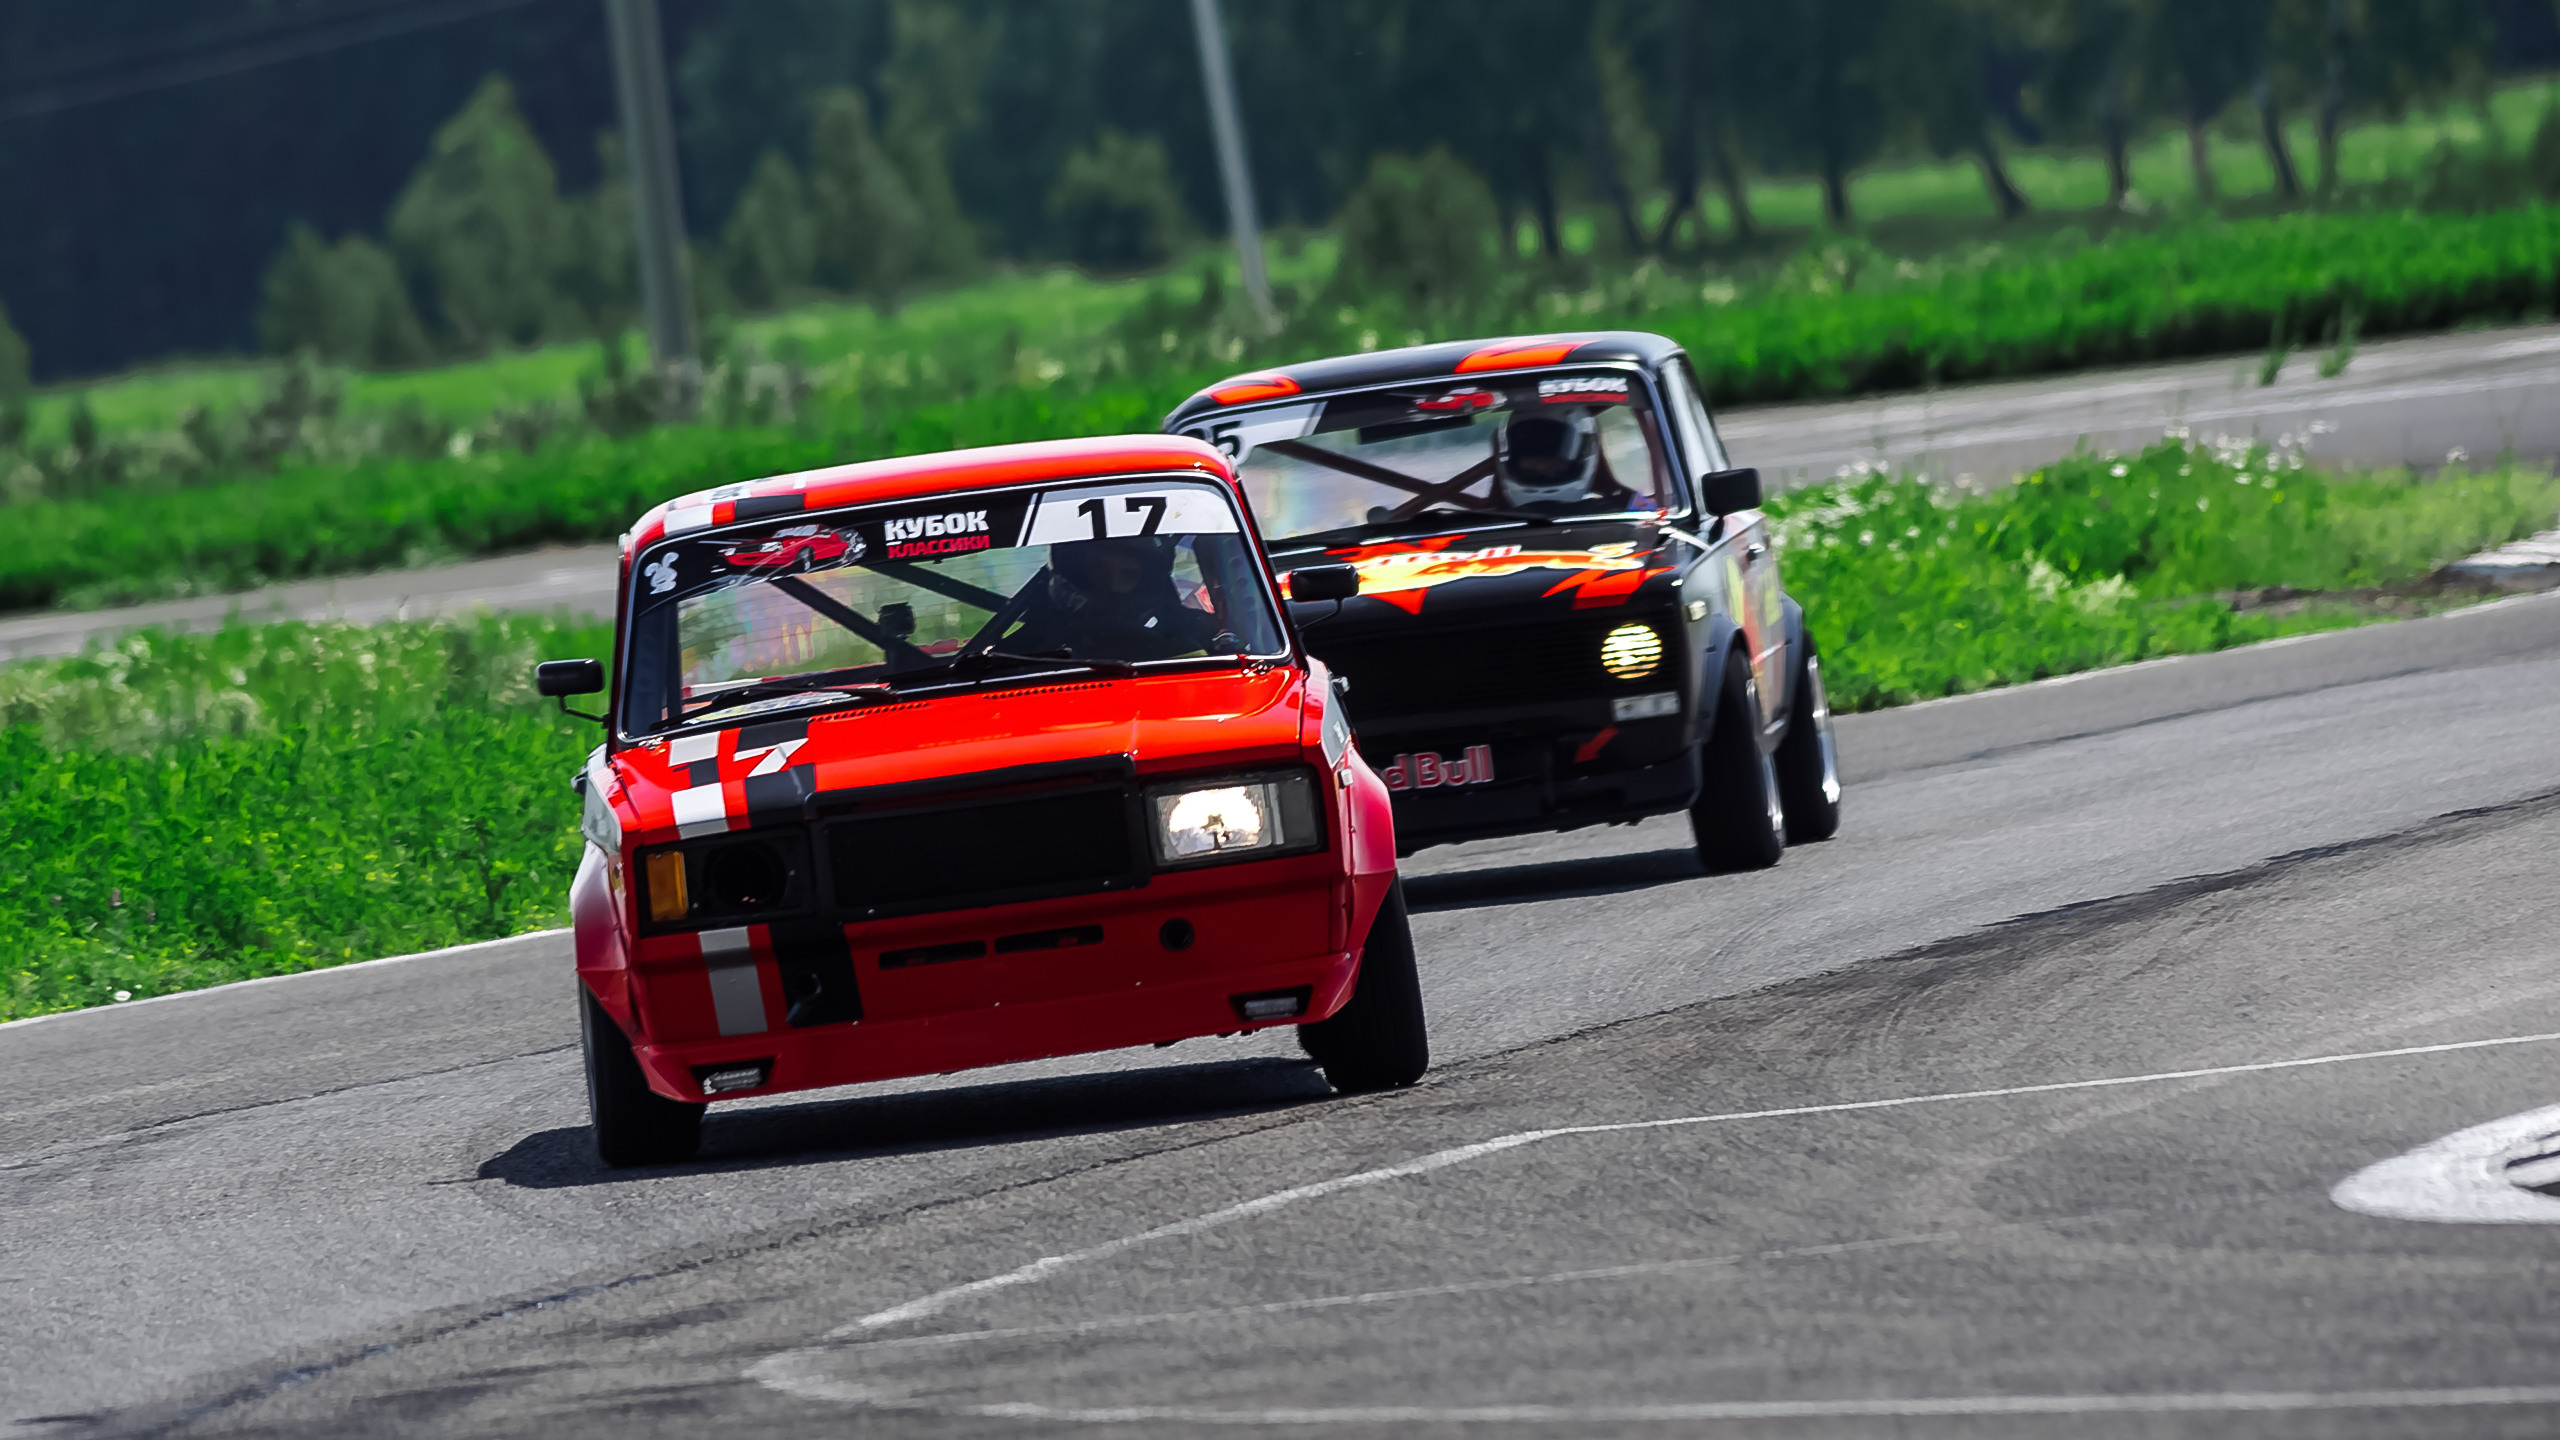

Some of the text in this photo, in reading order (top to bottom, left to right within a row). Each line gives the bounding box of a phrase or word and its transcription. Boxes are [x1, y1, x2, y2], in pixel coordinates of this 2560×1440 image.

[884, 510, 989, 542] КУБОК
[1077, 496, 1167, 538] 17
[888, 535, 990, 559] КЛАССИКИ
[1412, 744, 1494, 789] Bull
